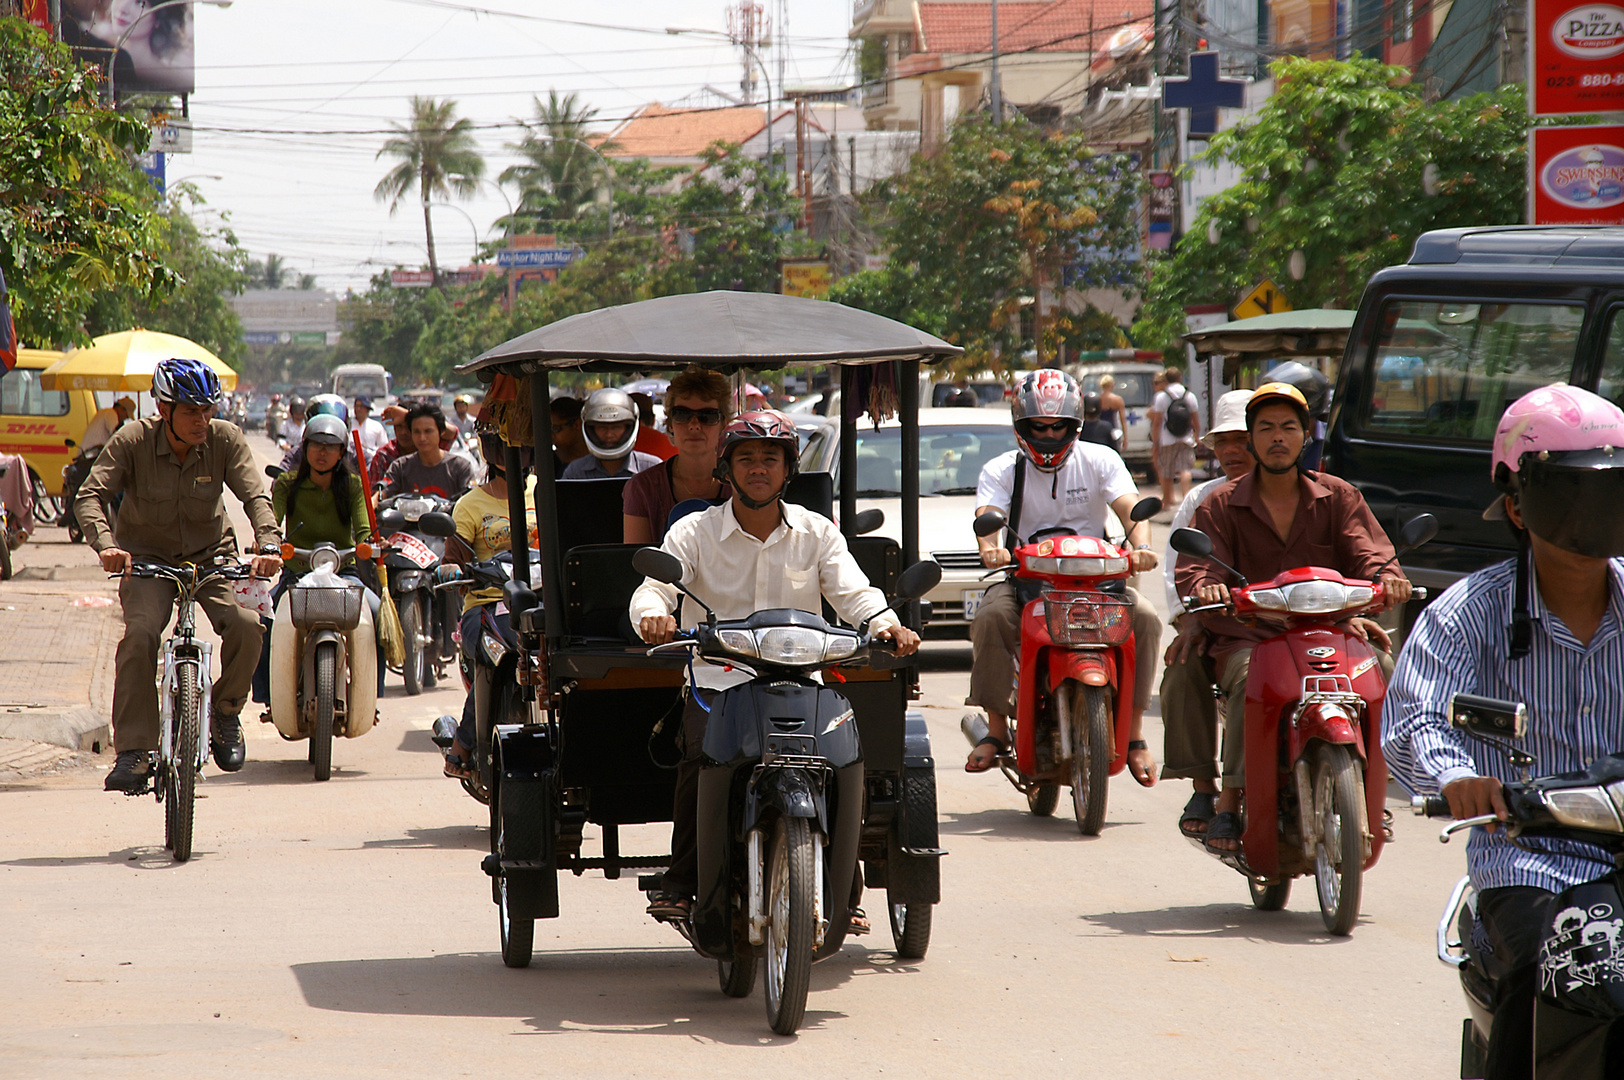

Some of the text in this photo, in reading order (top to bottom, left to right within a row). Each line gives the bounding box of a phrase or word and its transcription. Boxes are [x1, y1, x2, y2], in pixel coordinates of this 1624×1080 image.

[1589, 13, 1607, 21] The
[1578, 40, 1616, 48] Company
[530, 252, 553, 265] Night
[6, 424, 58, 435] DHL
[770, 680, 802, 688] HONDA
